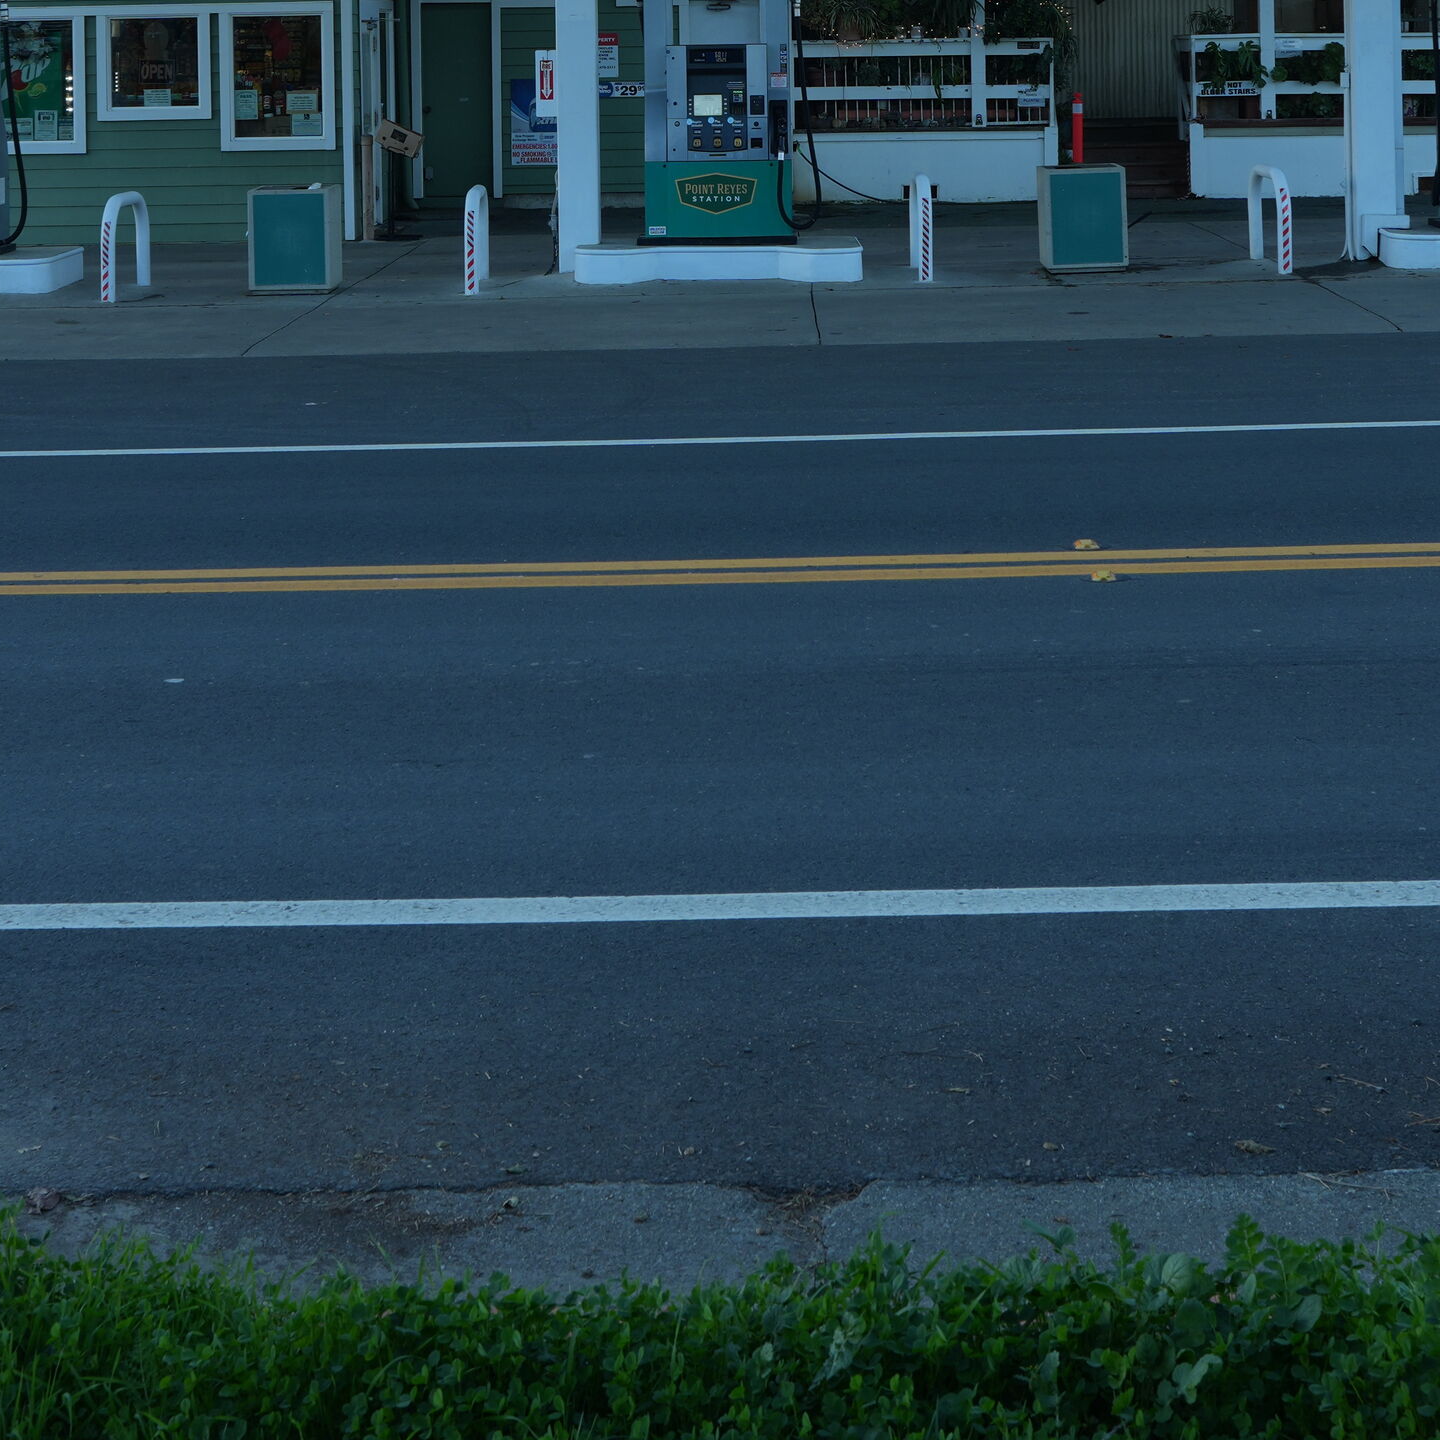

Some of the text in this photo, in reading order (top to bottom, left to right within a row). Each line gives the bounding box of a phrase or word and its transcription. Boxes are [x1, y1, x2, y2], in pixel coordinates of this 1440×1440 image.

[141, 63, 173, 80] OPEN
[685, 183, 748, 195] POINT REYES
